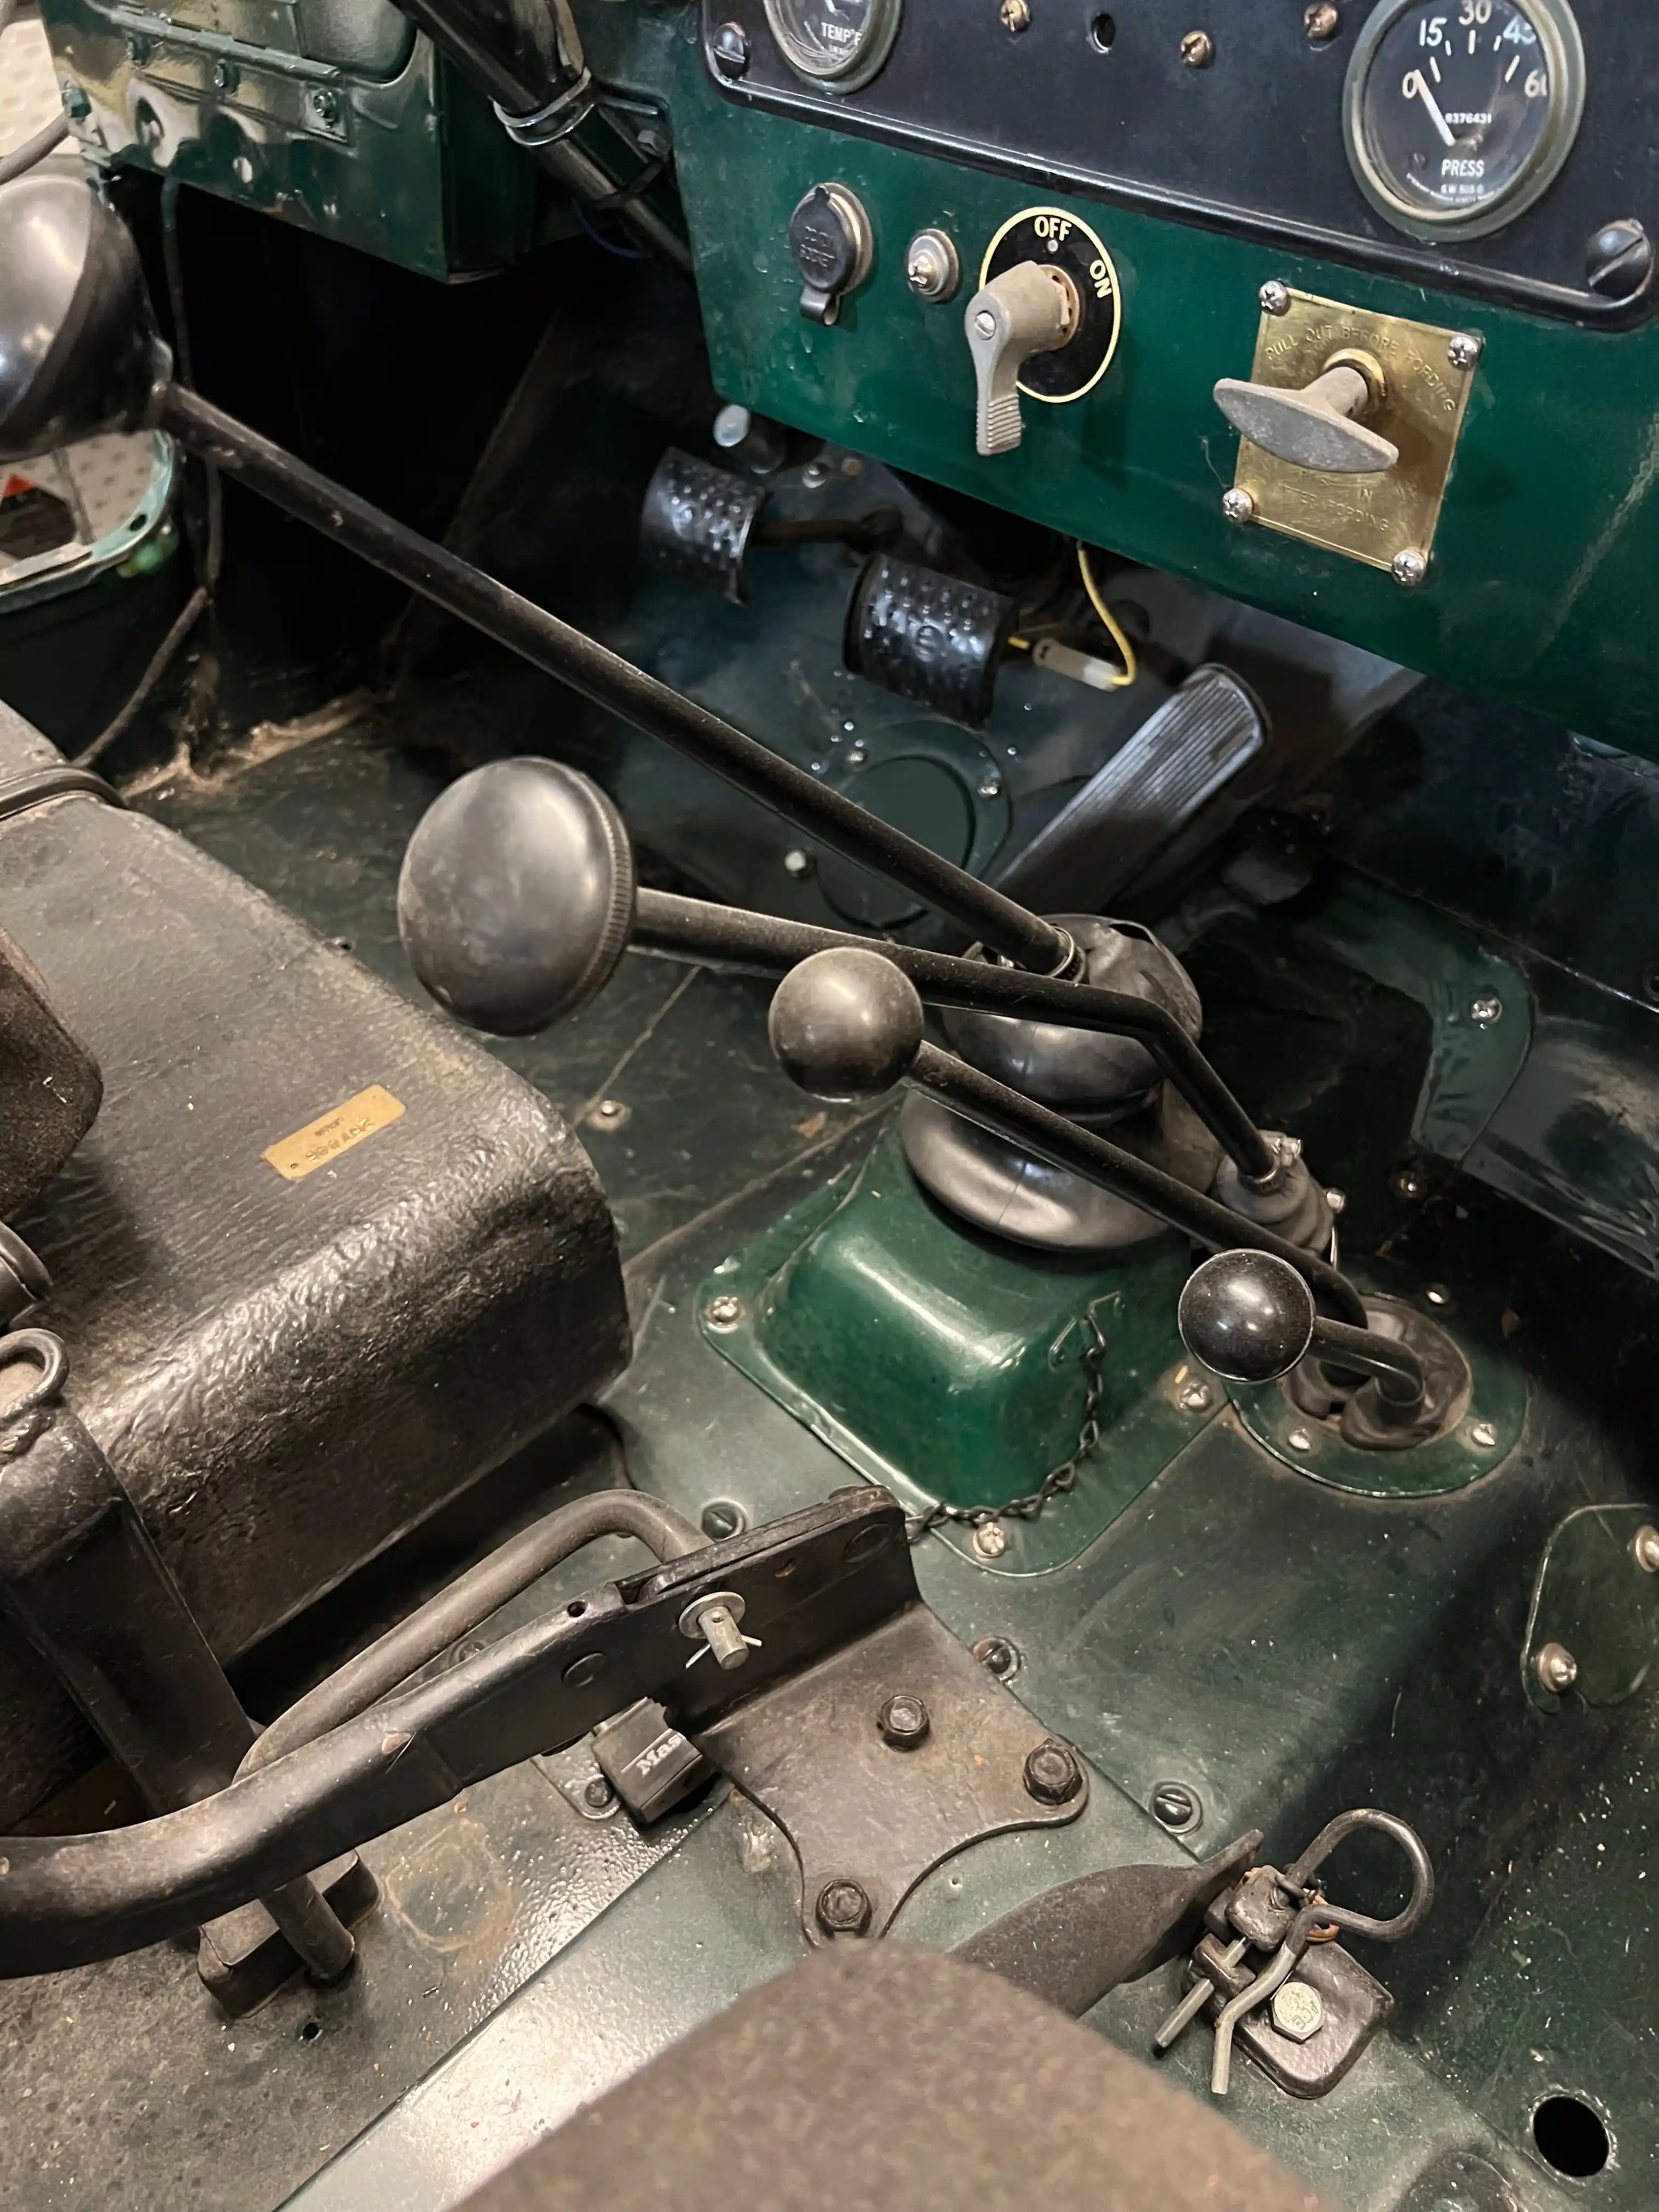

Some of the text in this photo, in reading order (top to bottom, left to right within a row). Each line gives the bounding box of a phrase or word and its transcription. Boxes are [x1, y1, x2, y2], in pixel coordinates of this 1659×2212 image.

[1459, 0, 1492, 25] 30
[1419, 17, 1447, 46] 15
[1402, 72, 1418, 99] 0
[1441, 159, 1485, 178] PRESS
[1034, 216, 1072, 241] OFF
[1090, 259, 1112, 298] ON
[1265, 335, 1299, 360] PULL
[1306, 325, 1333, 341] OUT
[636, 1733, 686, 1778] Mas
